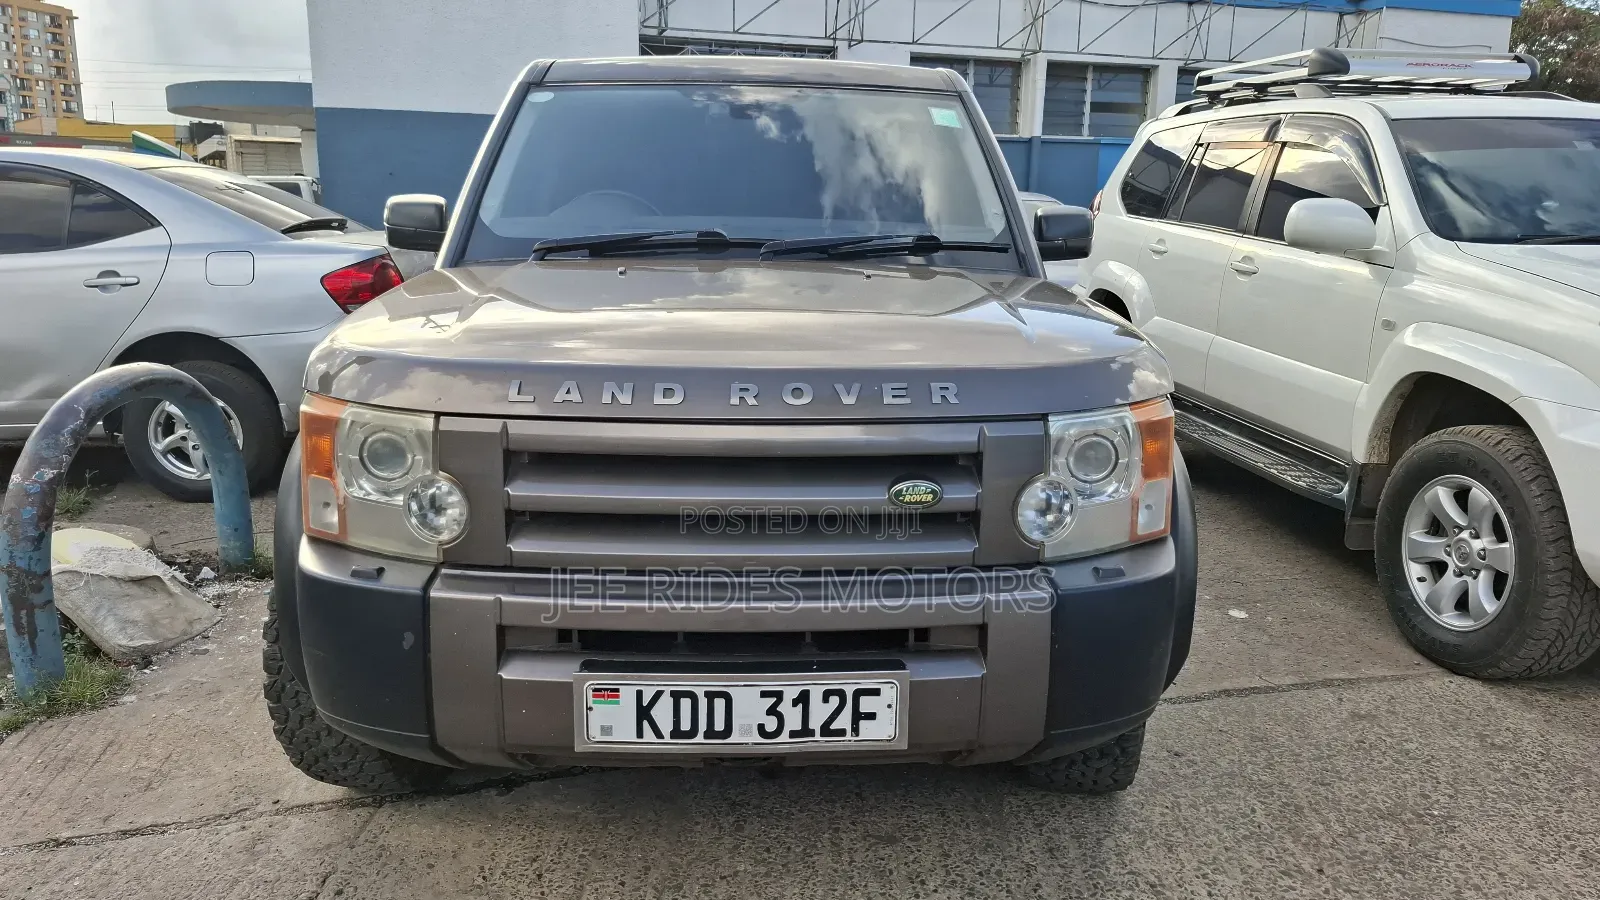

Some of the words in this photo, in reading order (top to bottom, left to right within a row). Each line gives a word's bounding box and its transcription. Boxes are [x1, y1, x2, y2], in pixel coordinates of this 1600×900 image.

[508, 380, 685, 405] LAND
[729, 382, 960, 406] ROVER
[902, 486, 926, 494] LAND
[904, 494, 933, 502] ROVER
[636, 689, 733, 739] KDD
[757, 688, 882, 738] 312F
